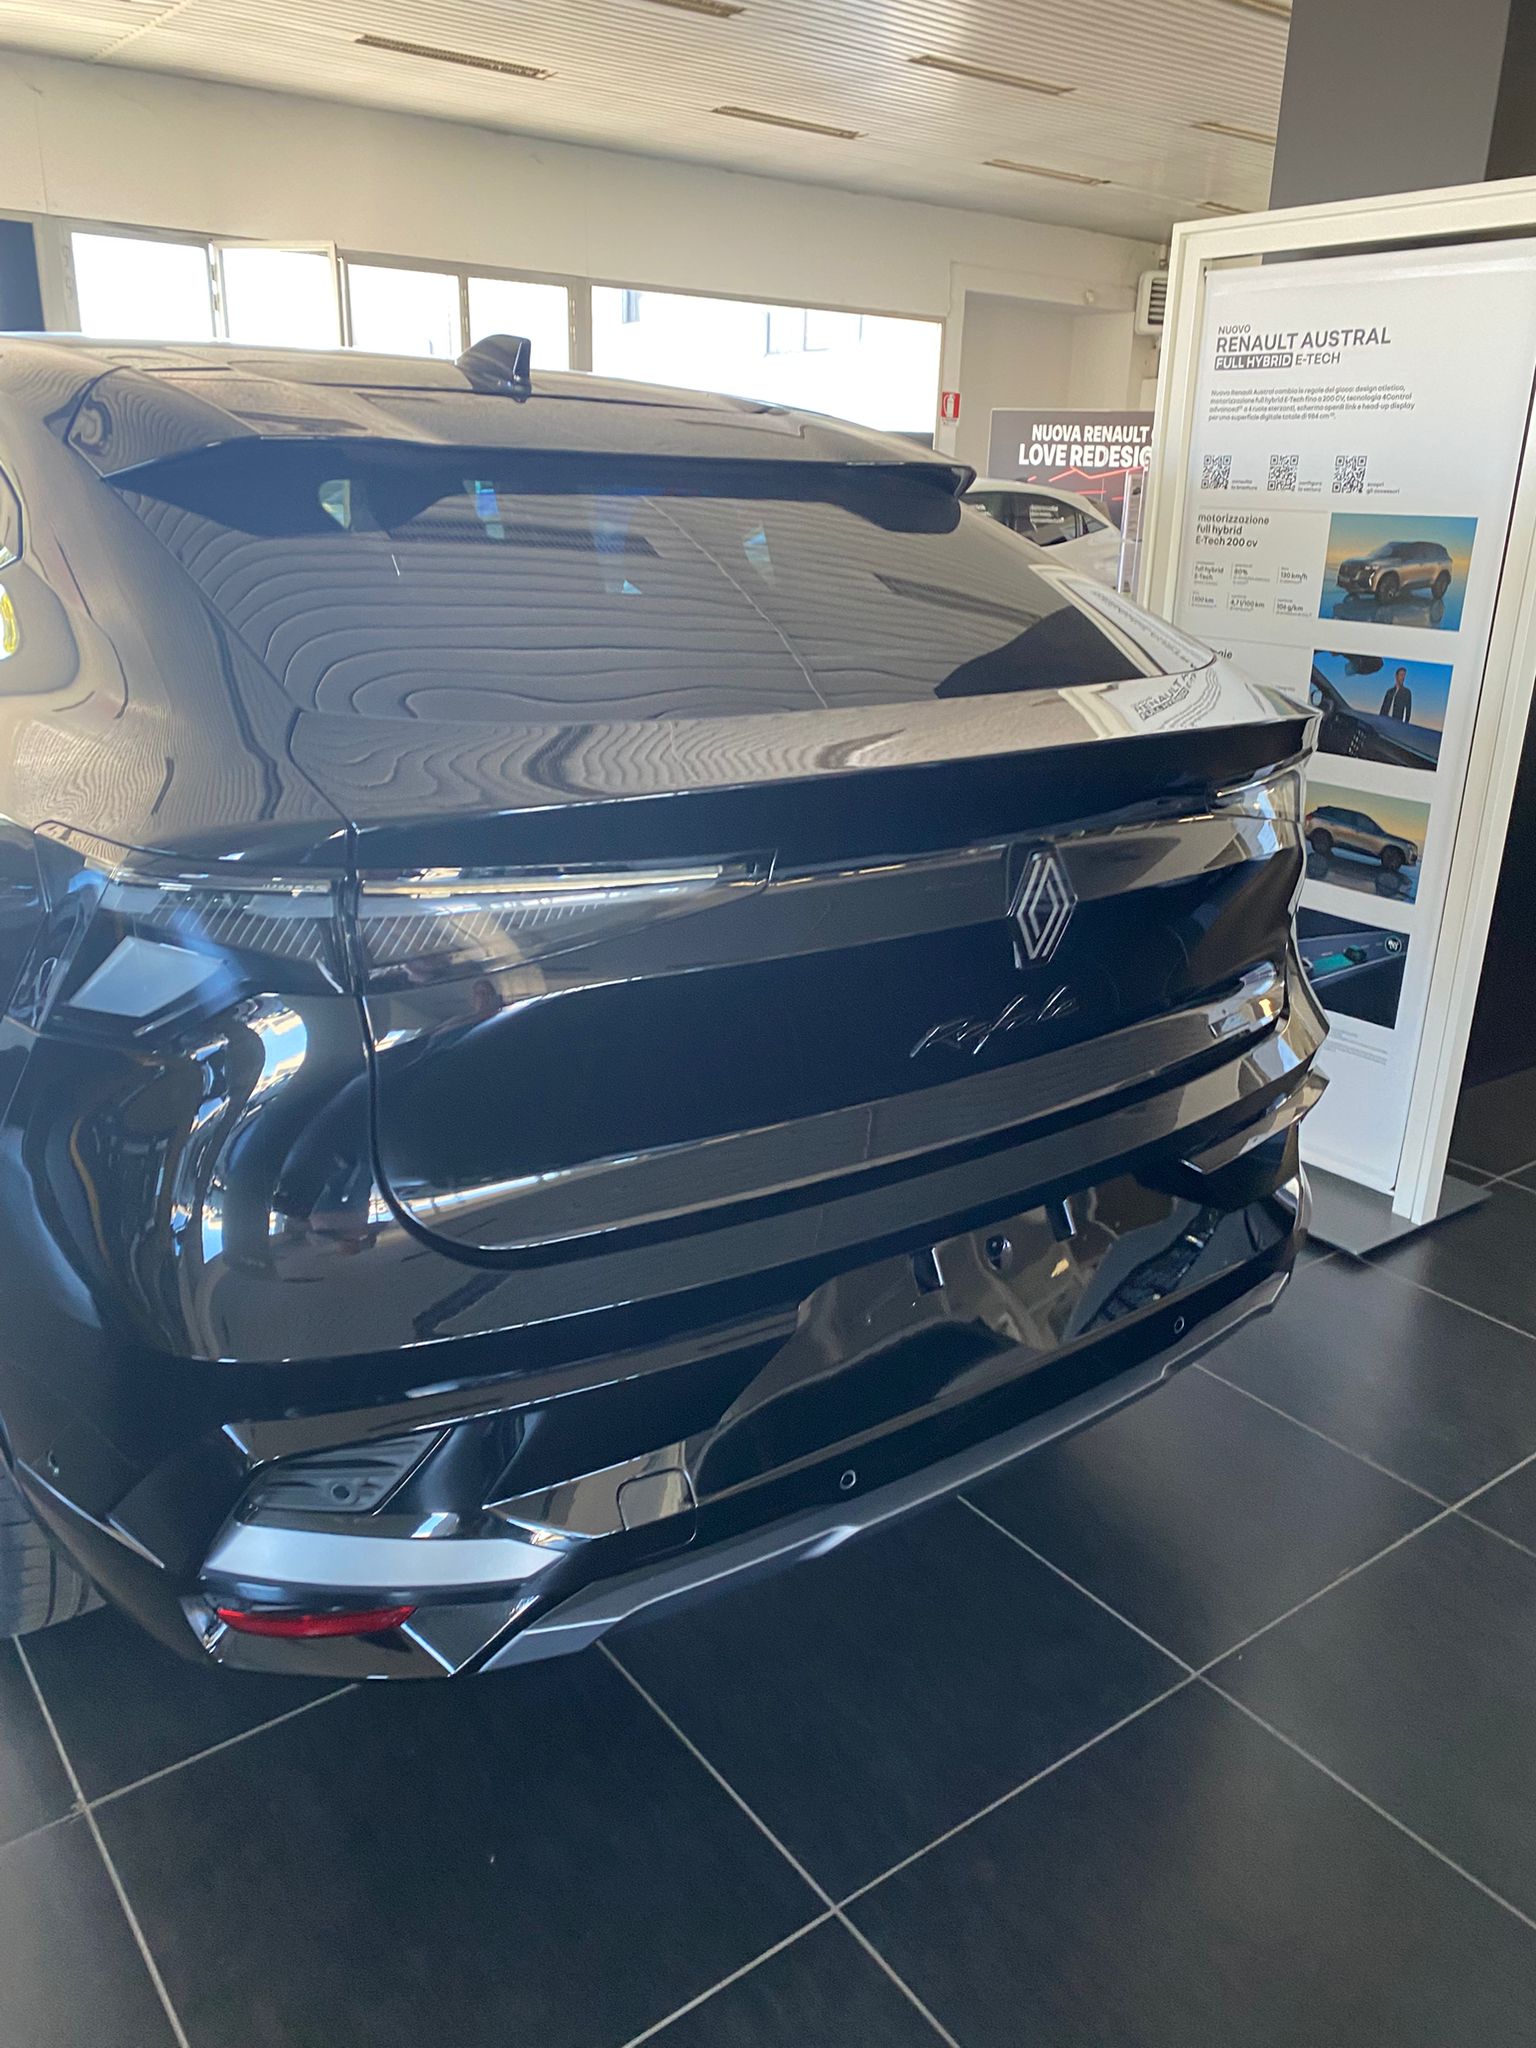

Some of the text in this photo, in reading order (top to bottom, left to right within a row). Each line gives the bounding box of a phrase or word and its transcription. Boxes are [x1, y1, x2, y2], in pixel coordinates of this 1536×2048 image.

[1218, 324, 1251, 335] NUOVO
[1216, 327, 1391, 353] RENAULT AUSTRAL
[1216, 352, 1341, 369] FULL HYBRID E-TECH
[1355, 384, 1377, 394] design
[1265, 396, 1284, 405] hybrid
[1346, 394, 1381, 402] tecnologia
[1382, 392, 1412, 400] 4Control
[1390, 401, 1416, 411] display
[1031, 424, 1081, 442] NUOVA
[1083, 425, 1150, 443] RENAULT
[1018, 443, 1067, 466] LOVE
[1198, 513, 1270, 526] motorizzazione
[1197, 524, 1243, 536] full hybrid
[1195, 535, 1258, 548] E-Tech 200 cv
